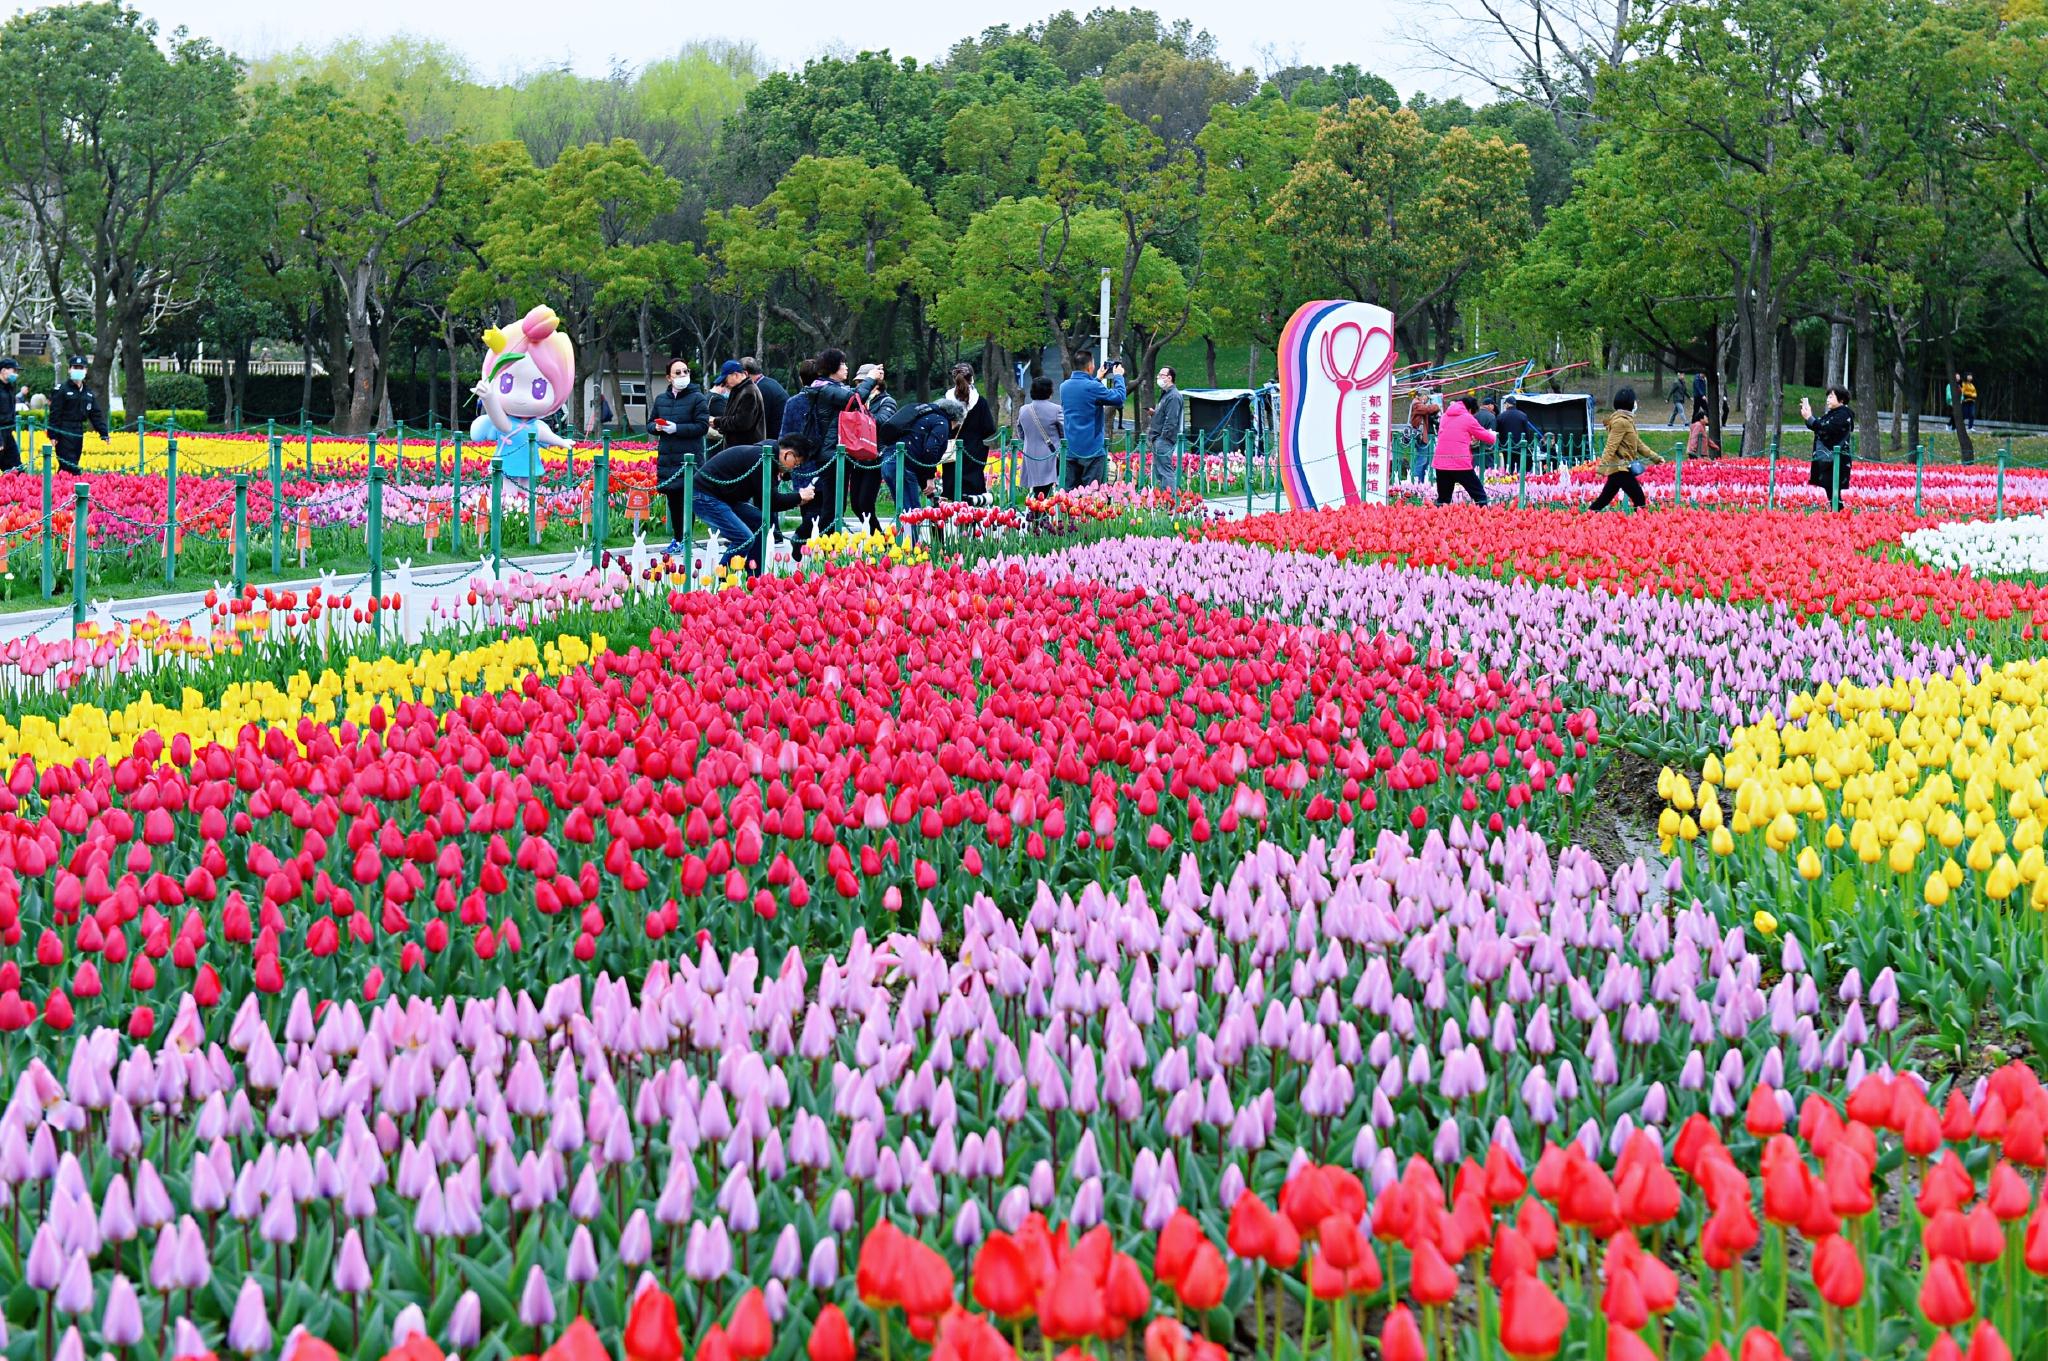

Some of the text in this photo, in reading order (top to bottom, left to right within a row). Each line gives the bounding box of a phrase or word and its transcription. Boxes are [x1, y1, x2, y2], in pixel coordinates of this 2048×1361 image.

[1366, 394, 1381, 492] 郁金香博物馆
